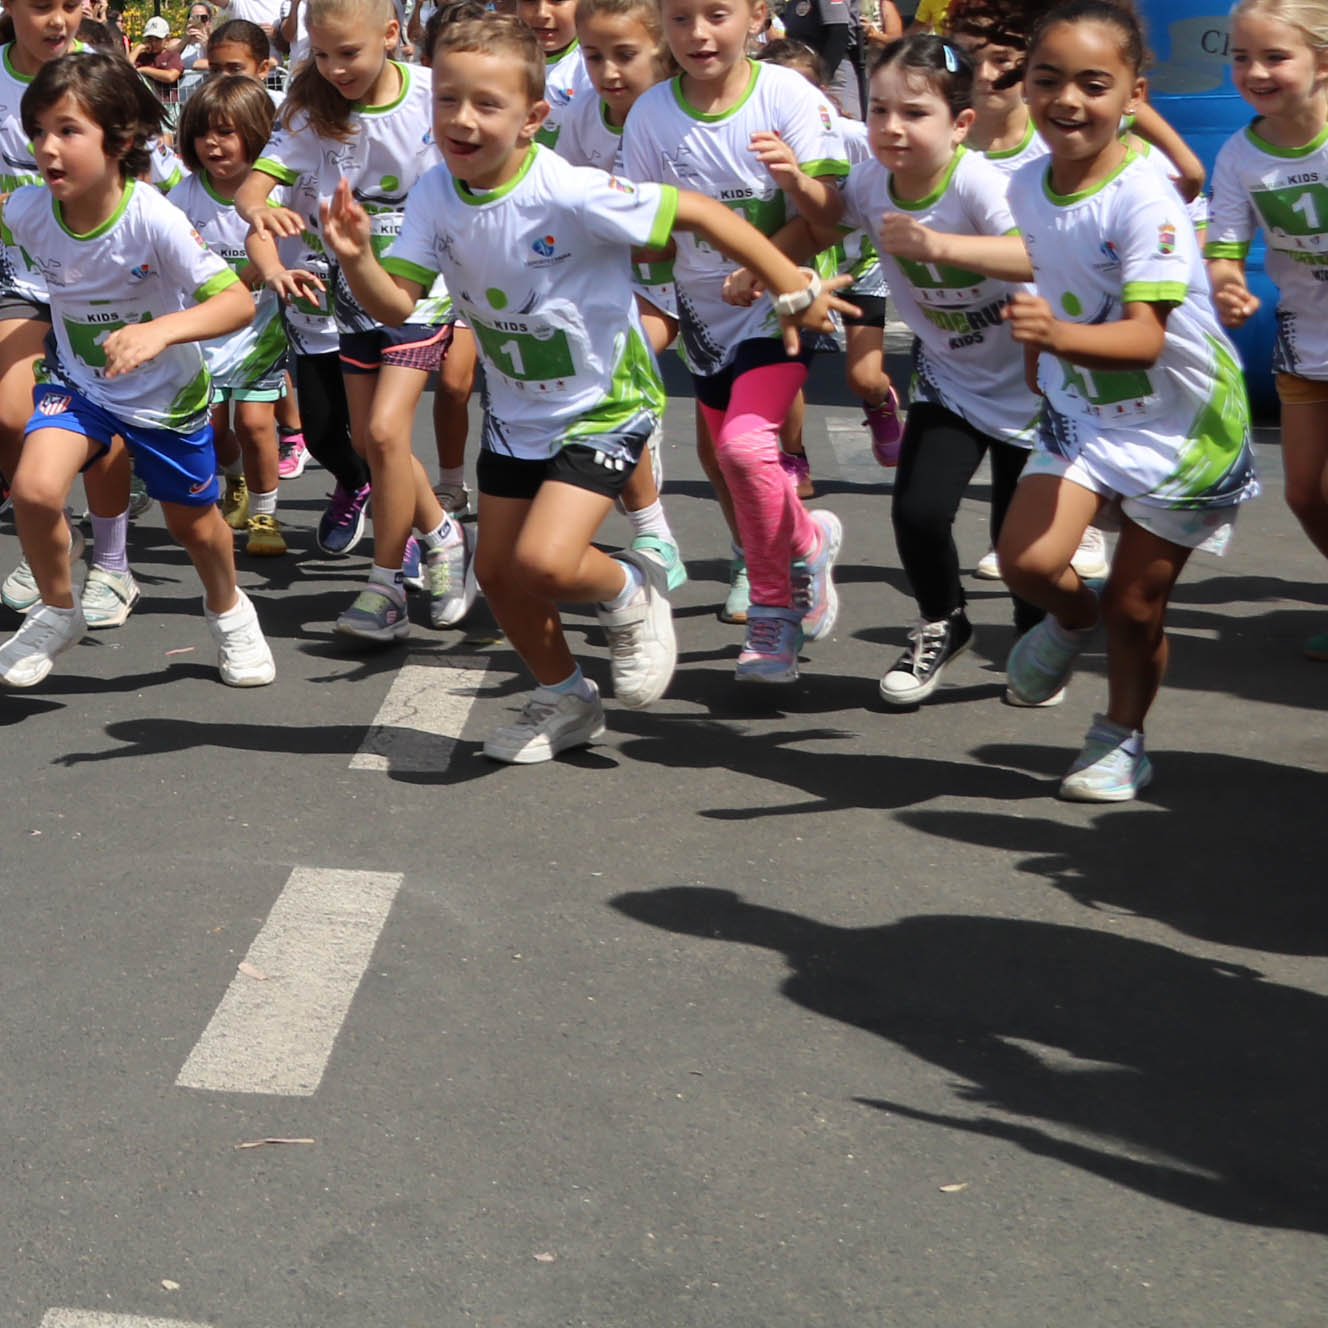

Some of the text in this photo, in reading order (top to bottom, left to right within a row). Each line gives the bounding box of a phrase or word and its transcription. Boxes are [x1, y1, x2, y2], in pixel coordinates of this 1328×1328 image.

[1288, 172, 1319, 184] KIDS
[720, 188, 753, 199] KIDS
[1291, 192, 1320, 229] 1
[87, 312, 120, 322] KIDS
[494, 319, 528, 333] KIDS
[949, 332, 984, 349] KIDS
[500, 340, 525, 375] 1
